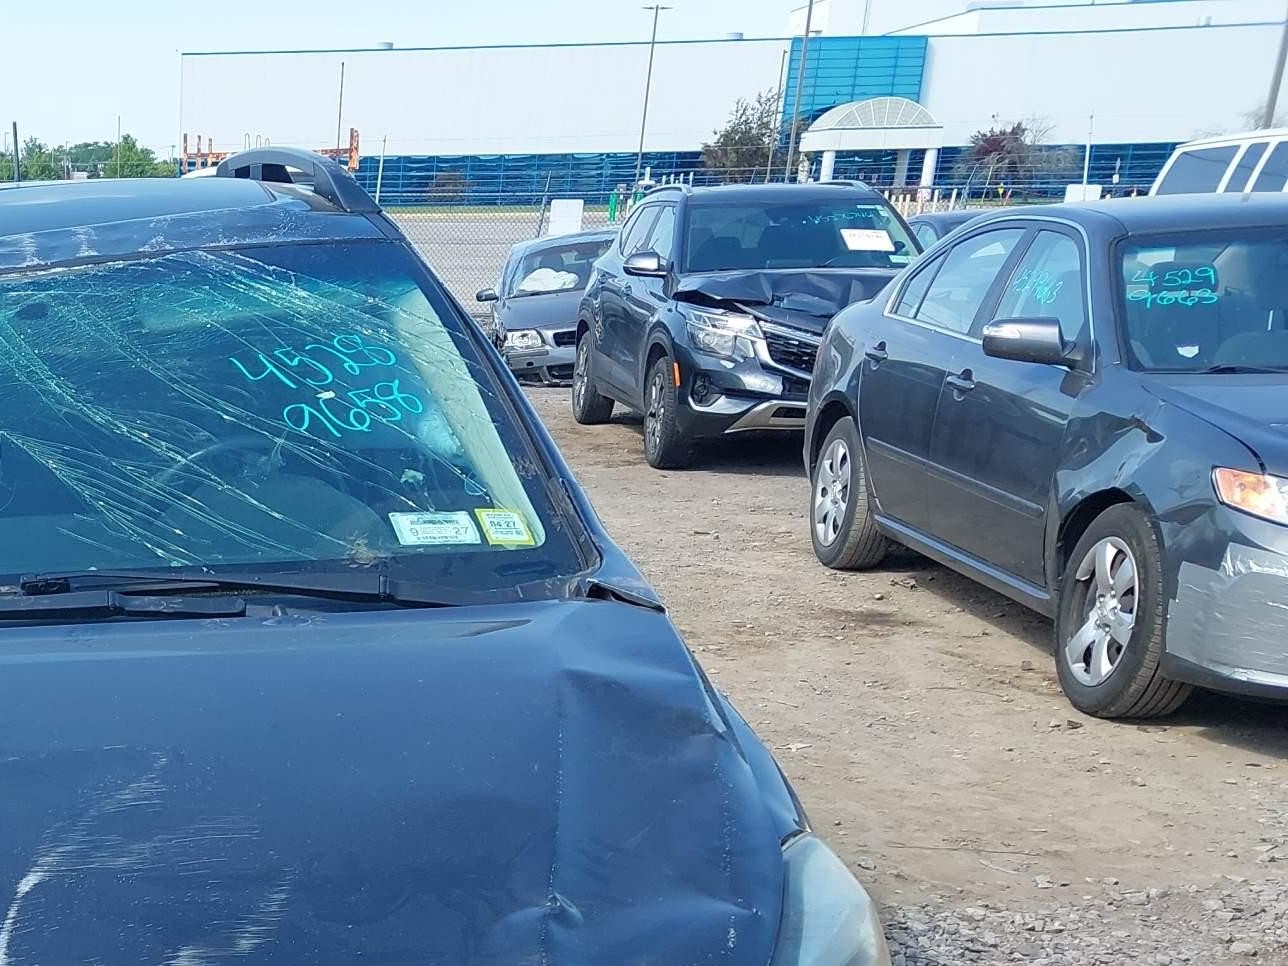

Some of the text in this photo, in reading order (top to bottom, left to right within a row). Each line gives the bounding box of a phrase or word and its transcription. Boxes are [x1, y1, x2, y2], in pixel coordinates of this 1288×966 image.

[1131, 266, 1215, 287] 4529
[1128, 288, 1219, 309] 9663
[229, 334, 397, 389] 4528
[283, 378, 423, 437] 9658
